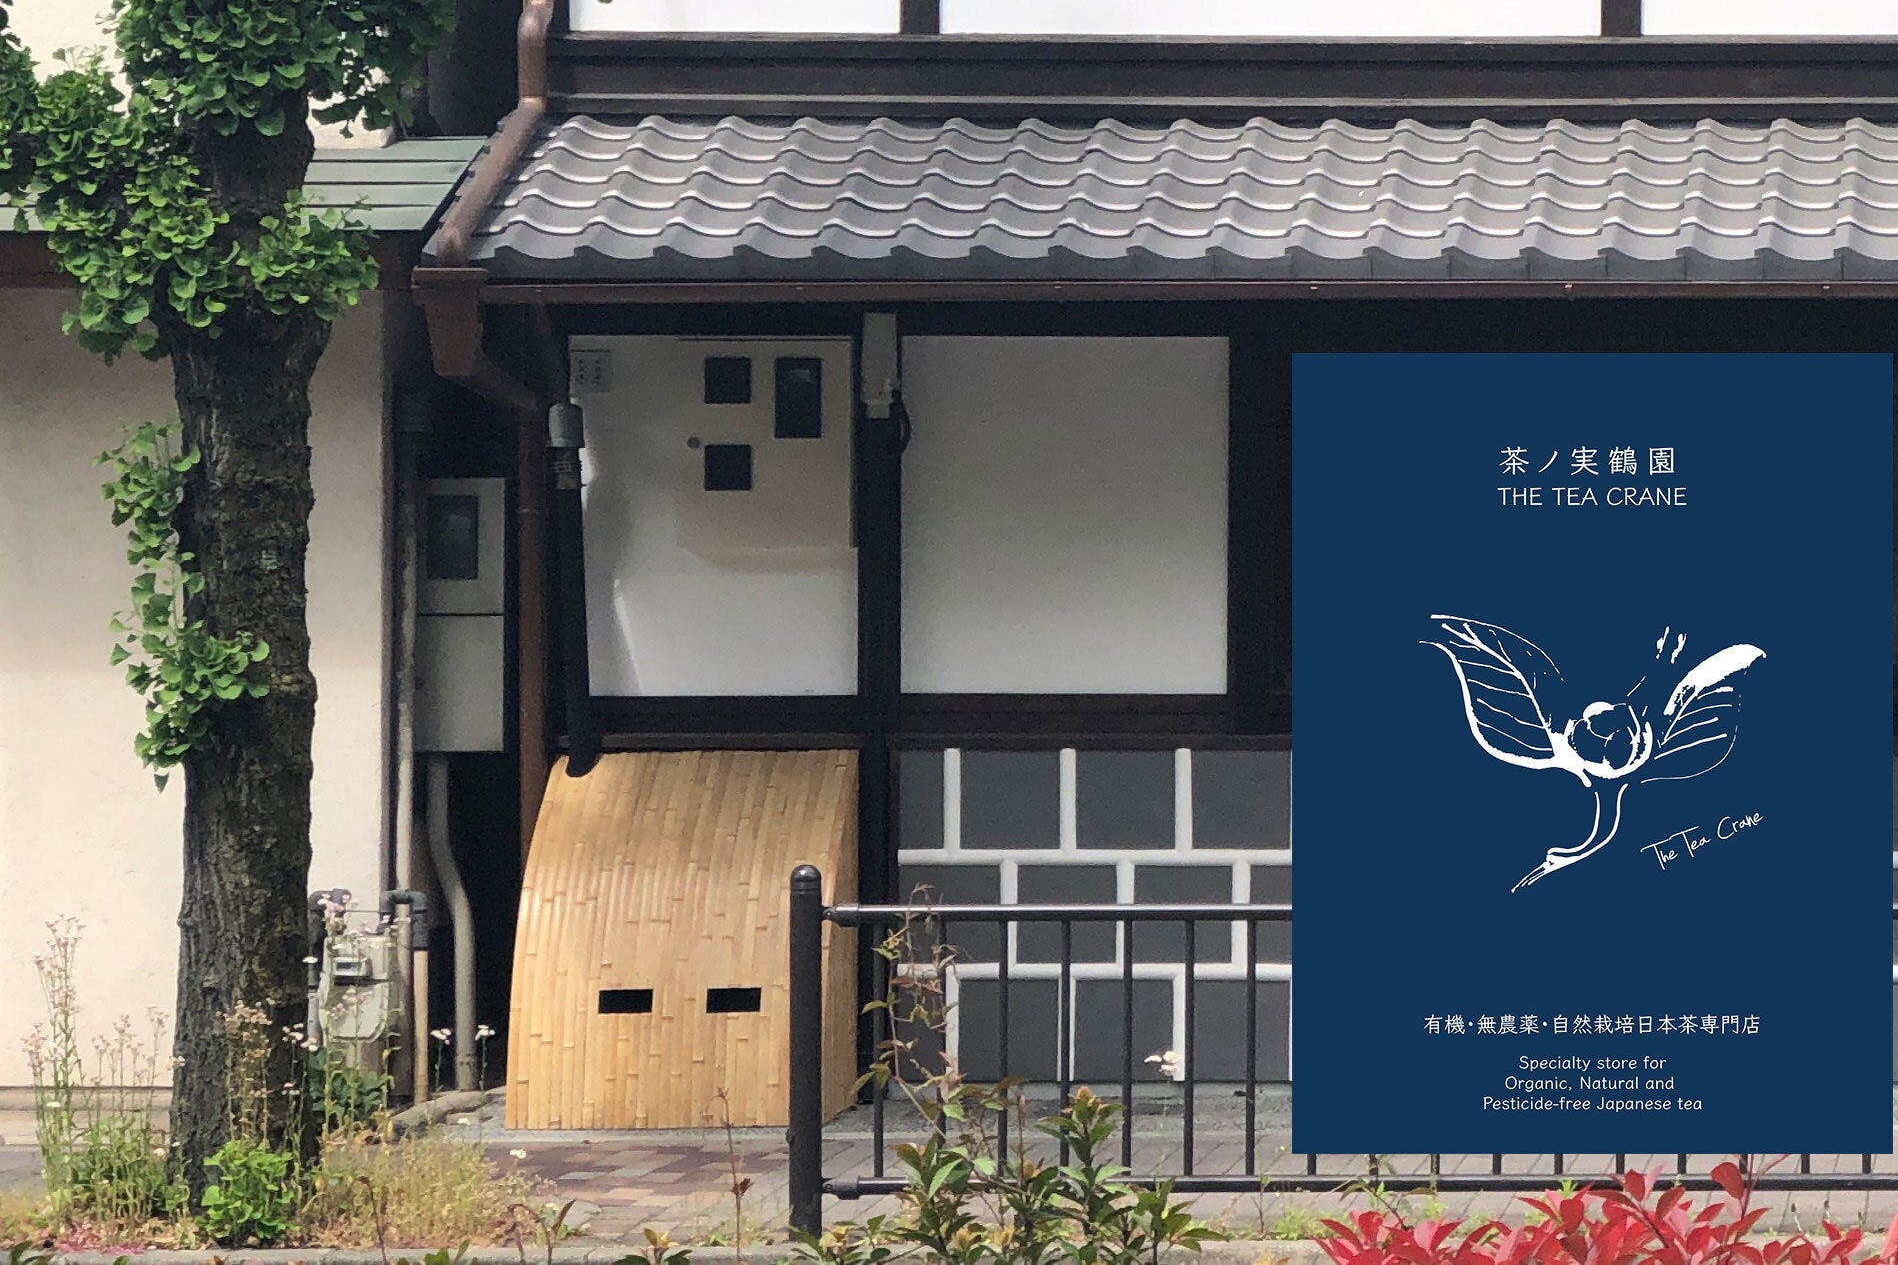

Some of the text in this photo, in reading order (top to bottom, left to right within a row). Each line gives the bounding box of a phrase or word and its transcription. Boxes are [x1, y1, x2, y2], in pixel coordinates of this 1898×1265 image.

[1499, 446, 1675, 476] 茶ノ実鶴園
[1498, 487, 1688, 506] THE TEA CRANE
[1640, 812, 1764, 870] The Tea Crane
[1423, 1014, 1761, 1035] 有機・無農薬・自然栽培日本茶専門店
[1518, 1056, 1667, 1072] Specialty store for
[1505, 1076, 1675, 1093] Organic, Natural and
[1483, 1097, 1703, 1113] Pesticide-free Japanese tea
